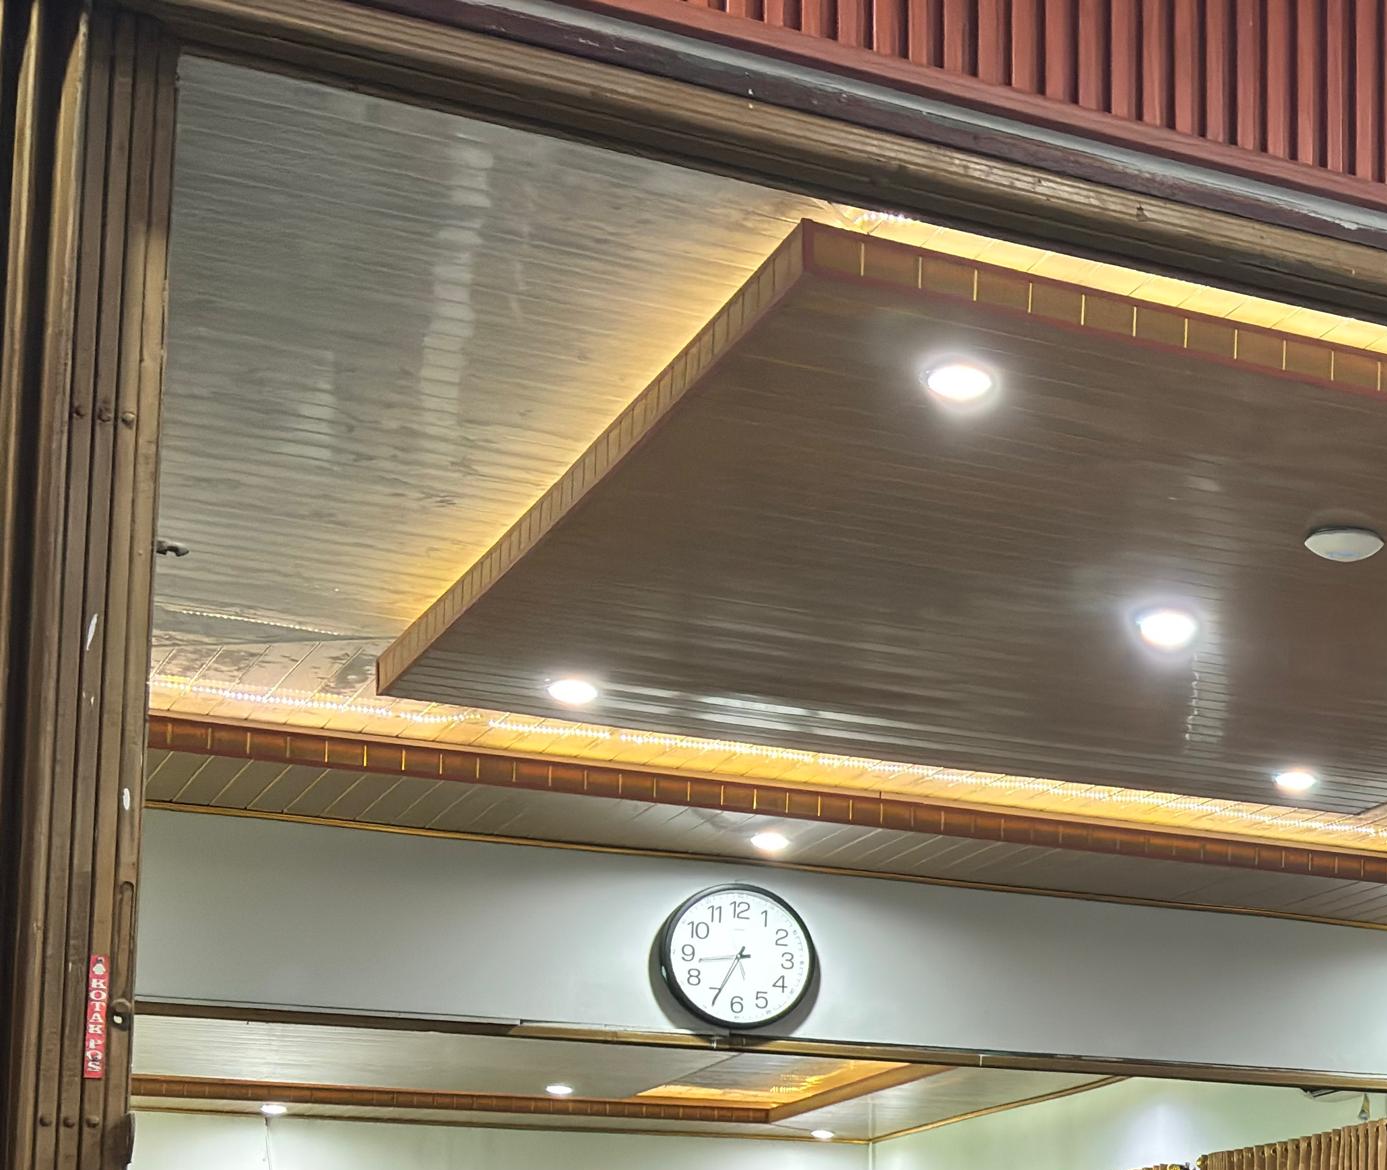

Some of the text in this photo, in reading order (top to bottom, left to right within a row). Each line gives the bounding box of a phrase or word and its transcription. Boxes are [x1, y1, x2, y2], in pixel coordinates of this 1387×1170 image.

[707, 905, 723, 923] 11
[729, 900, 751, 920] 12
[760, 909, 769, 928] 1
[687, 920, 710, 939] 10
[775, 928, 789, 947] 2
[681, 943, 696, 962] 9
[780, 951, 795, 970] 3
[687, 968, 701, 986] 8
[772, 975, 788, 993] 4
[708, 986, 722, 1007] 7
[730, 995, 744, 1014] 6
[755, 991, 769, 1009] 5
